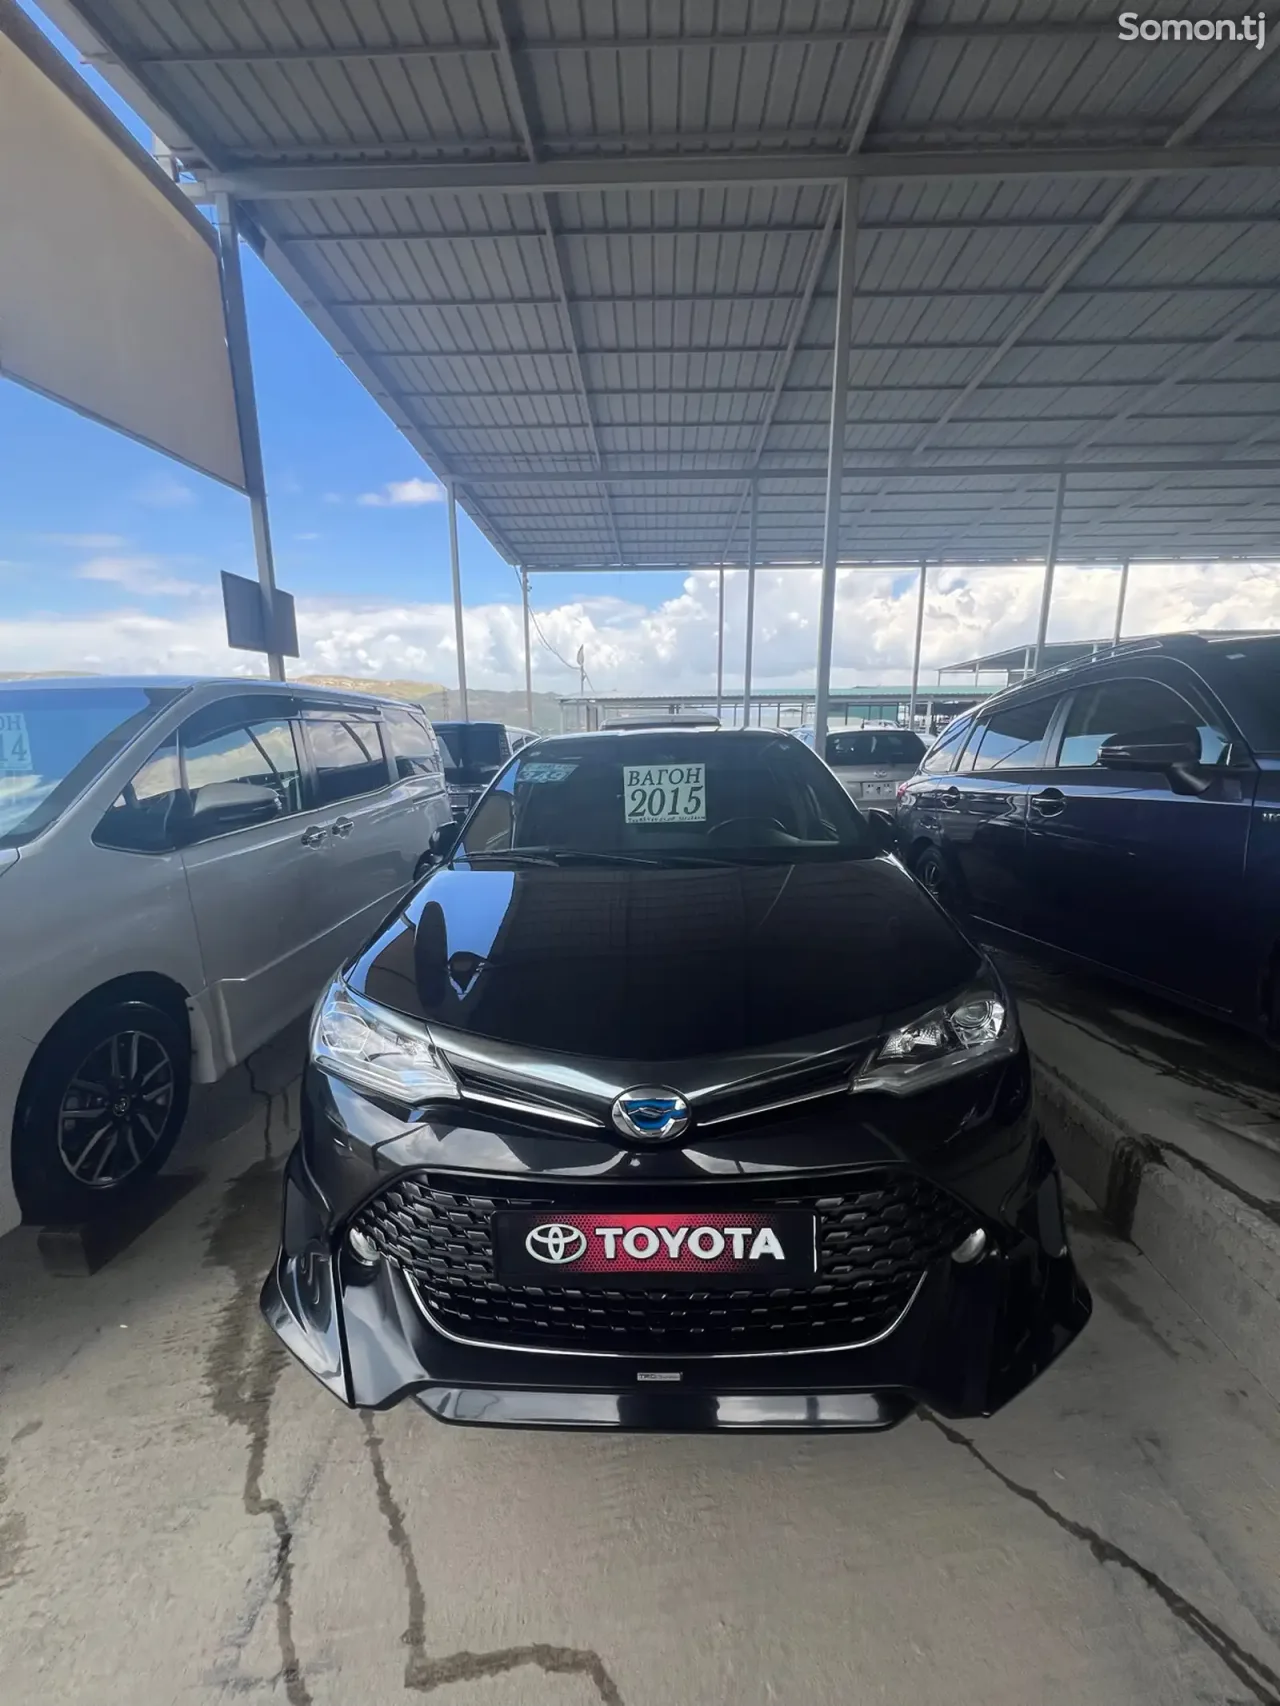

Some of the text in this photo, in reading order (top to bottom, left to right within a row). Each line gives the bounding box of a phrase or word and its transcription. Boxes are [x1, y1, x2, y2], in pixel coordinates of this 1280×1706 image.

[627, 767, 702, 787] ВАГОН
[628, 785, 704, 817] 2015
[595, 1226, 785, 1260] TOYOTA
